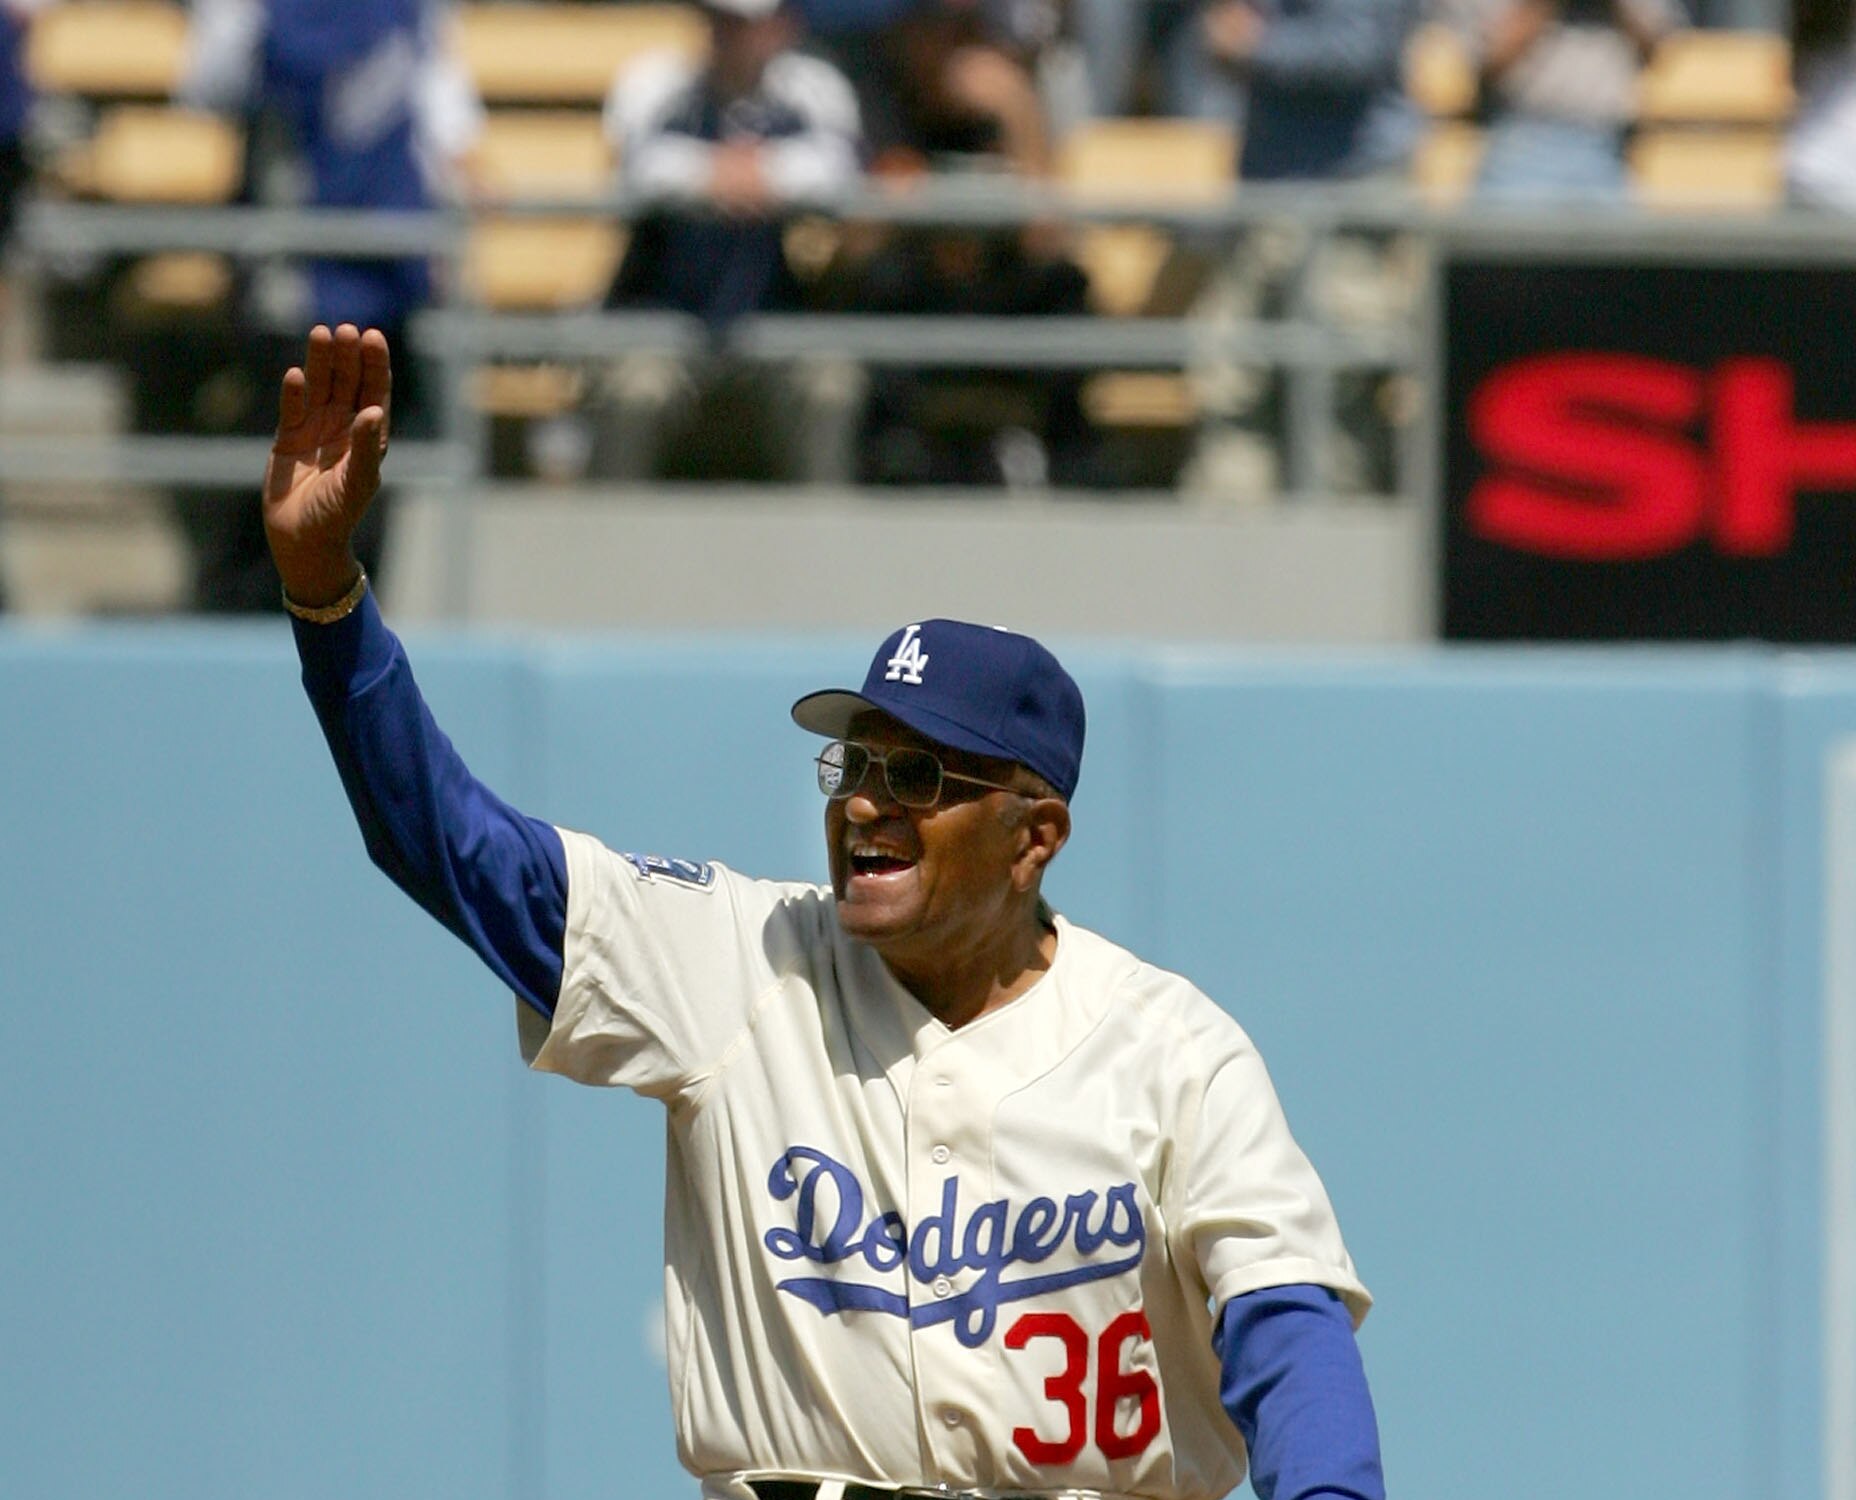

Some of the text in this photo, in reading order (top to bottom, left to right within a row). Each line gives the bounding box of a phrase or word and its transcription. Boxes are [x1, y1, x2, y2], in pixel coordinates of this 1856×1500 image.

[885, 624, 929, 684] LA
[764, 1145, 1146, 1348] Dodgers
[1004, 1311, 1160, 1465] 36
